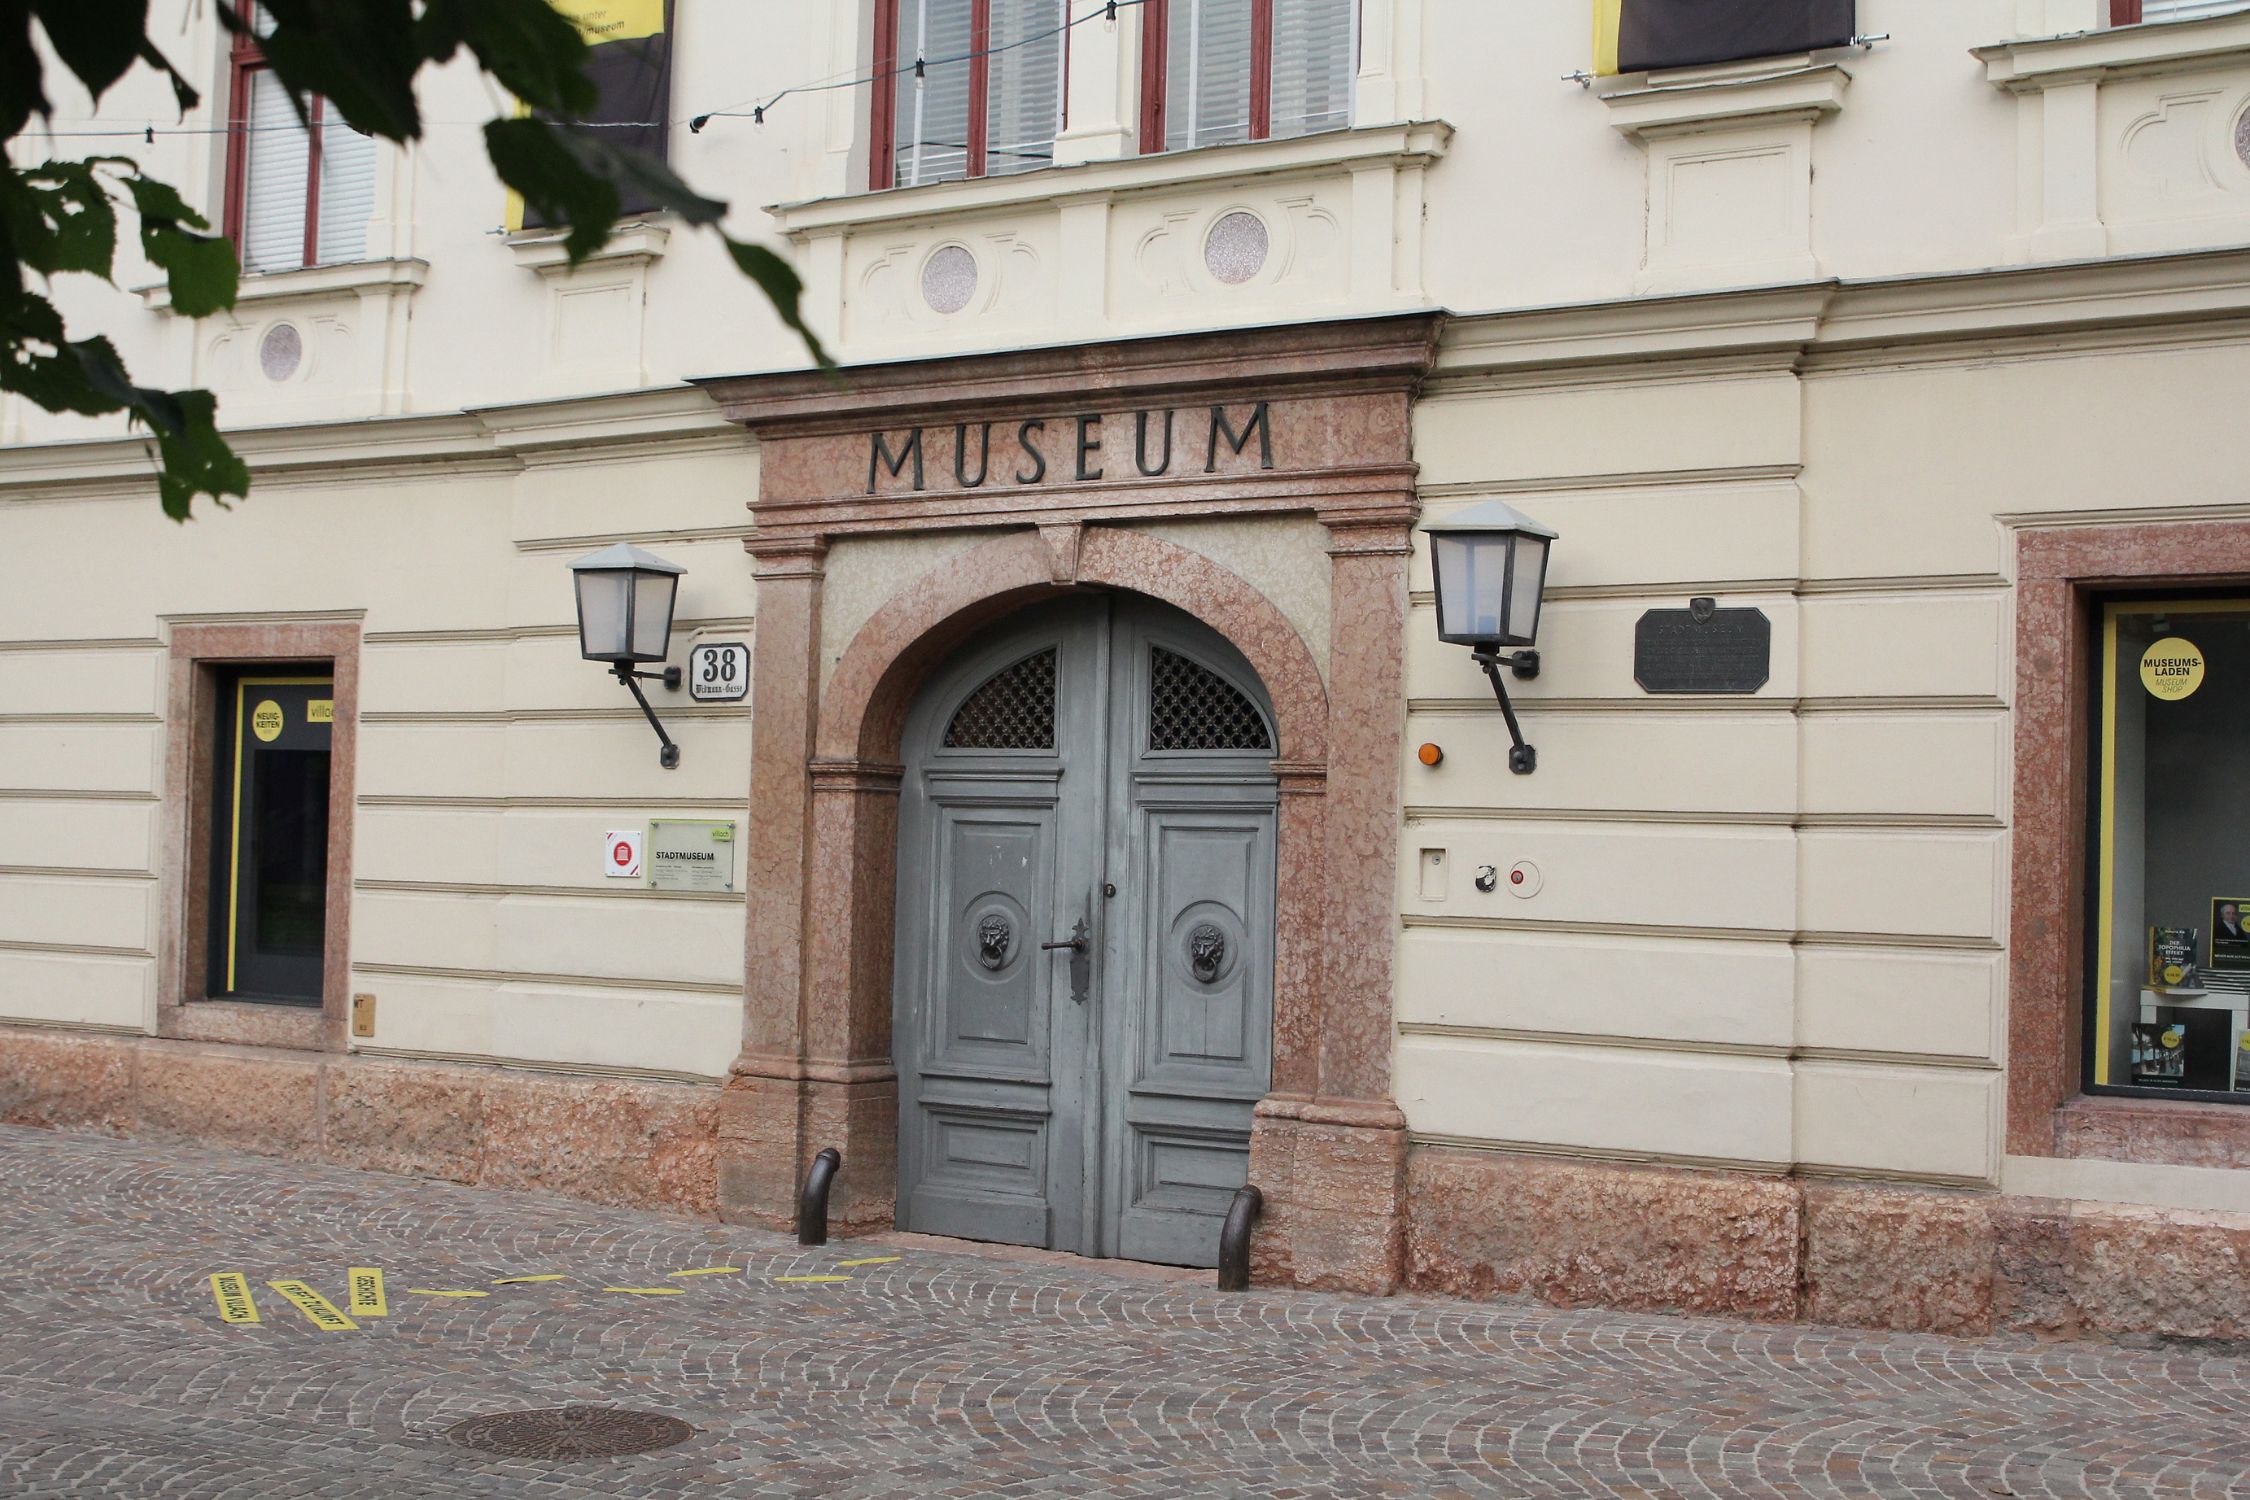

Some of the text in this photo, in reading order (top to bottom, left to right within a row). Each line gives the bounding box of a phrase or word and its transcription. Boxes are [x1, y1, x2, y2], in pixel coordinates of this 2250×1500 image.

[866, 402, 1274, 494] MUSEUM
[703, 649, 736, 682] 38
[2144, 658, 2201, 667] MUSEUMS-
[2155, 668, 2190, 676] LADEN
[2156, 678, 2187, 686] MUSEUM
[256, 720, 280, 728] KEITEN
[656, 851, 714, 860] STADTMUSEUM
